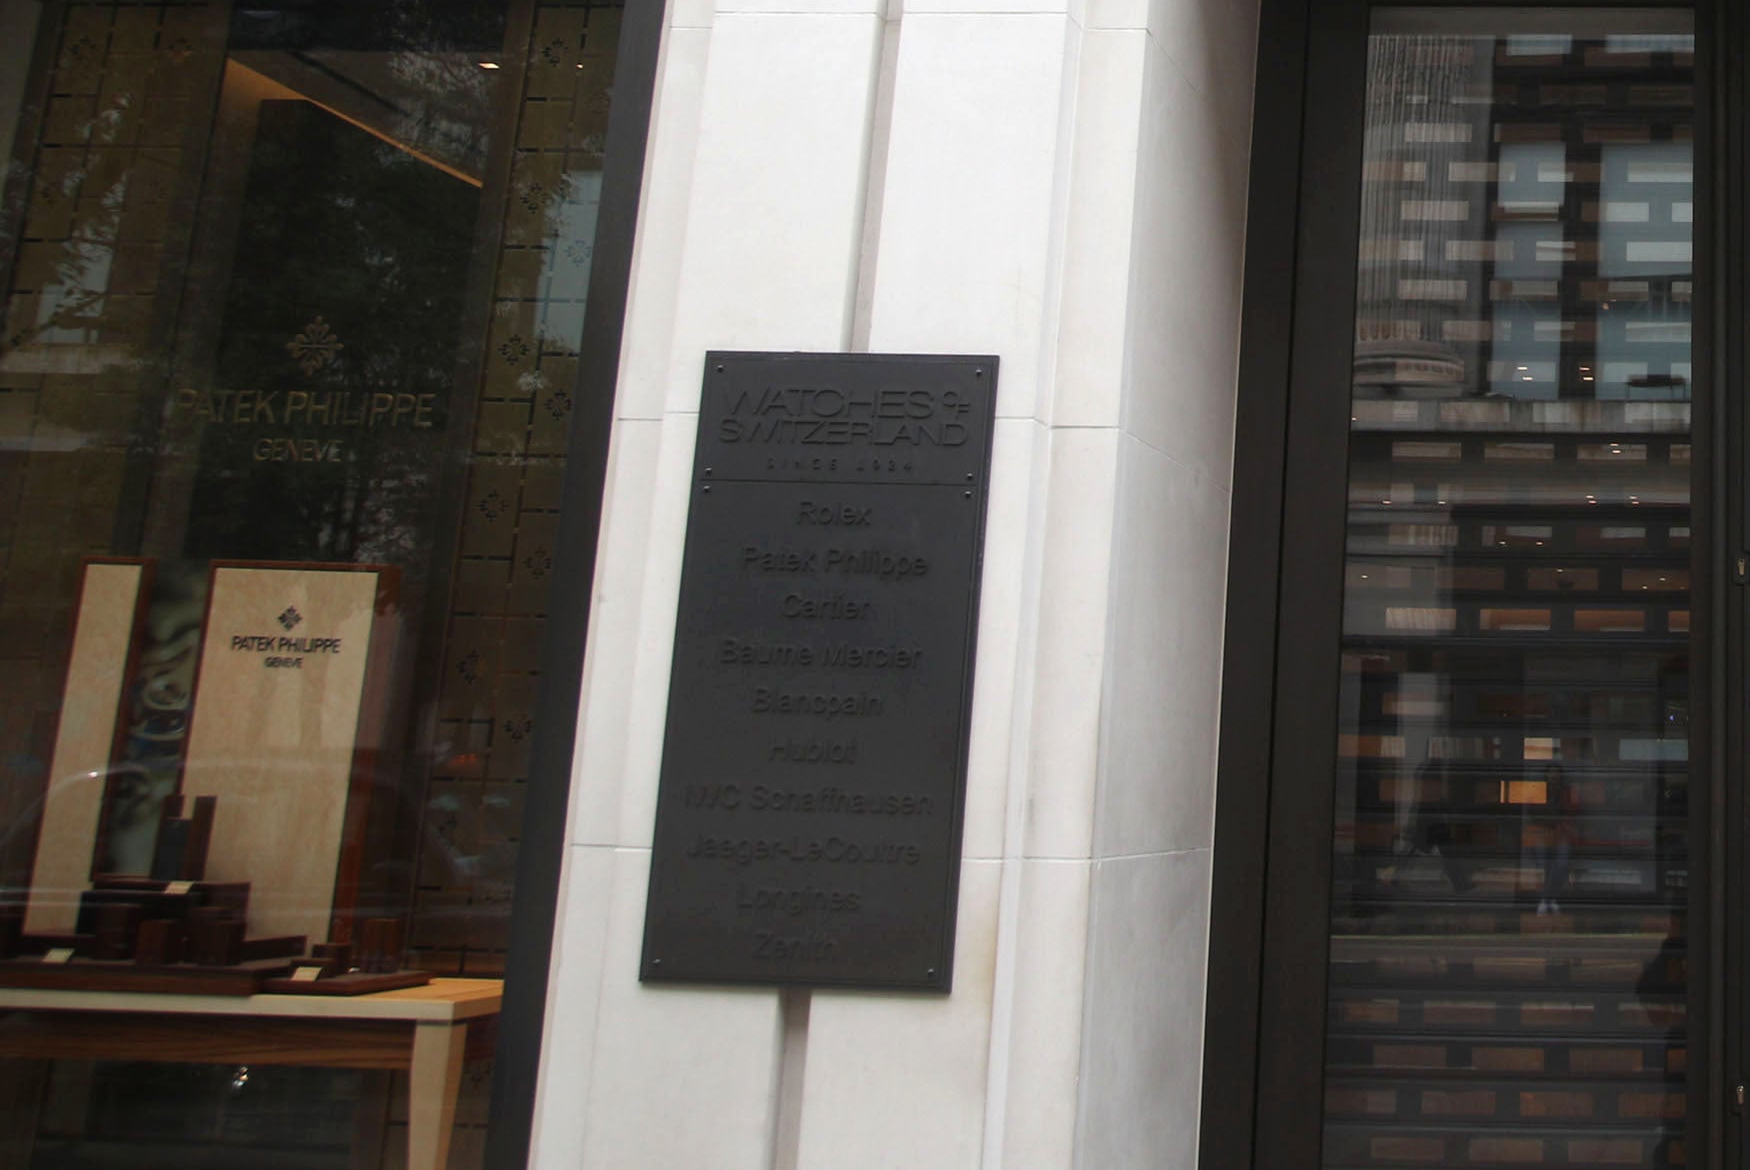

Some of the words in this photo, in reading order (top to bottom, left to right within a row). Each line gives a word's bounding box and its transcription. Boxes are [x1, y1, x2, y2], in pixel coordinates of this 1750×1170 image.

[175, 388, 279, 425] PATEK
[283, 390, 438, 430] PHILIPPE
[723, 388, 935, 419] WATCHES
[942, 390, 972, 420] OF
[718, 418, 970, 447] SWITZERLAND
[767, 455, 839, 472] SINCE
[797, 500, 873, 527] Rolex
[742, 546, 818, 574] Patek
[824, 548, 930, 582] Philippe
[782, 593, 872, 621] Cartier
[232, 636, 276, 652] PATEK
[278, 637, 342, 654] PHILIPPE
[719, 638, 813, 668] Baume
[822, 642, 924, 670] Mercier
[751, 687, 883, 720] Blancpain
[769, 735, 859, 766] Hublot
[684, 783, 741, 812] IWC
[748, 784, 935, 816] Schaffhausen
[685, 833, 921, 867] Jaeger-LeCoultre
[736, 884, 861, 916] Longines
